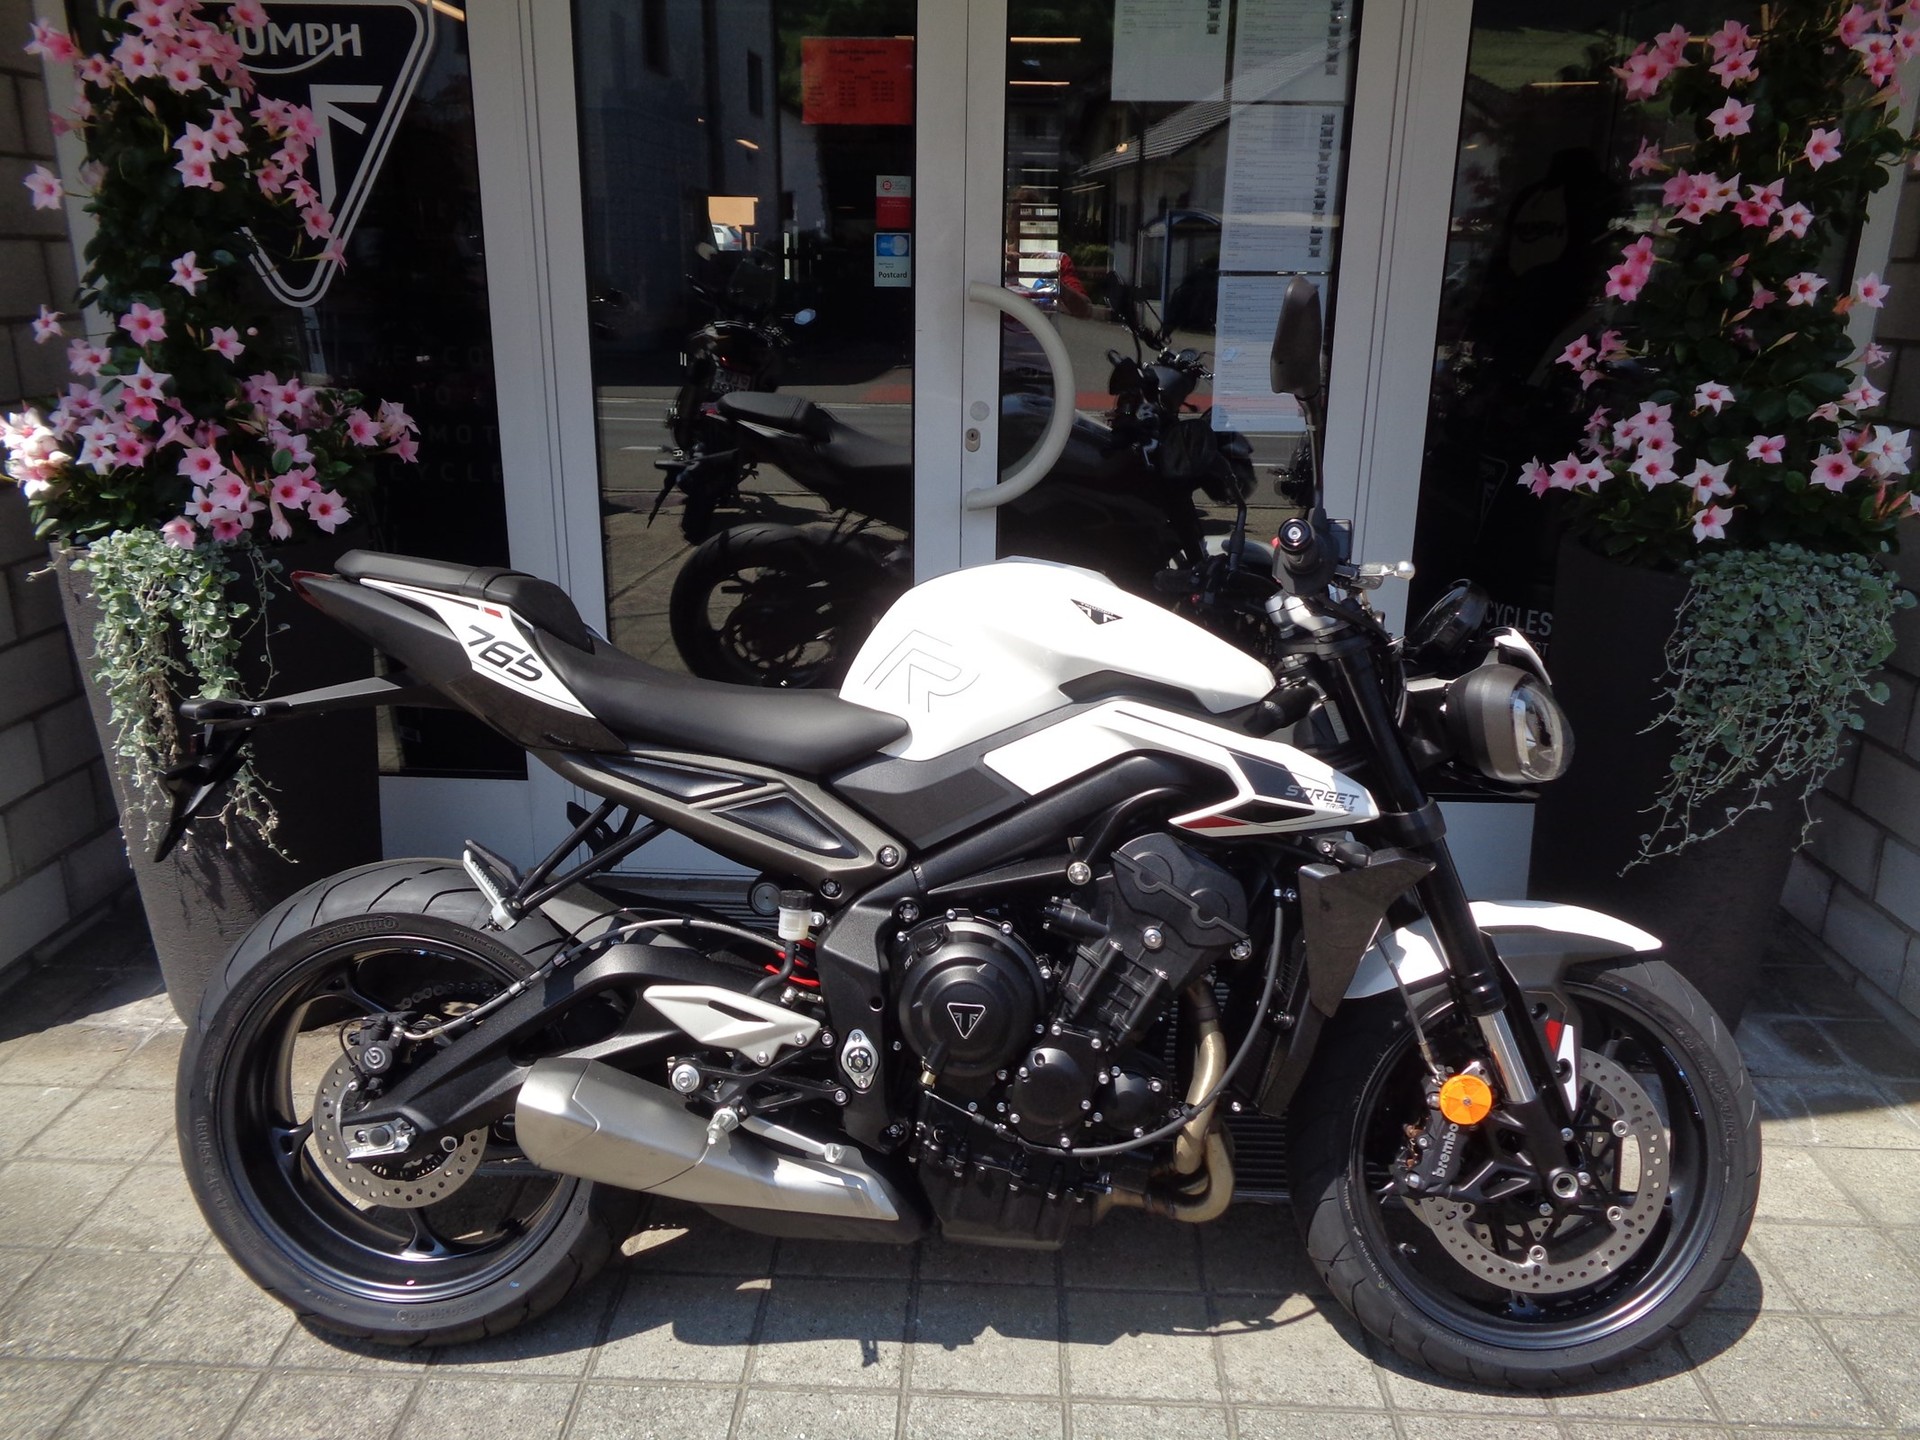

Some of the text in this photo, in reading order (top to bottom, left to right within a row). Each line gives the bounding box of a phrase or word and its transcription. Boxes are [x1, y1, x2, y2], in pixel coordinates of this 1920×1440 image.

[878, 270, 908, 279] Postcard
[468, 624, 543, 682] 765
[1285, 785, 1360, 806] STREET
[1325, 802, 1355, 812] TRIPLE
[1432, 1123, 1460, 1178] brembo
